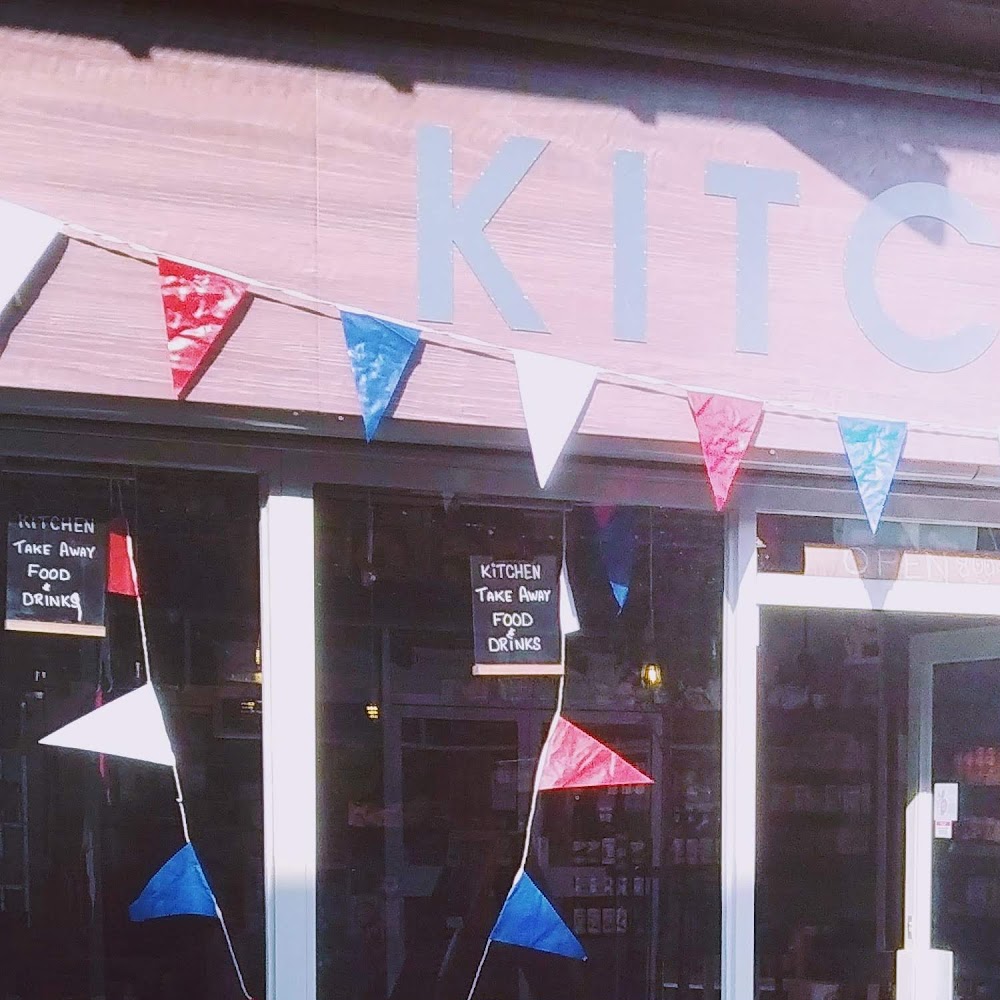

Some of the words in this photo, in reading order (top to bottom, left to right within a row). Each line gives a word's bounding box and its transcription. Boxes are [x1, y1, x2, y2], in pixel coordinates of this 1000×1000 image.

[18, 513, 95, 534] KITCHEN
[12, 539, 53, 556] TAKE
[59, 541, 97, 559] AWAY
[27, 563, 71, 581] FOOD
[22, 592, 82, 615] DRINKS
[475, 586, 513, 603] TAKE
[518, 585, 552, 603] AWAY
[492, 611, 534, 627] FOOD
